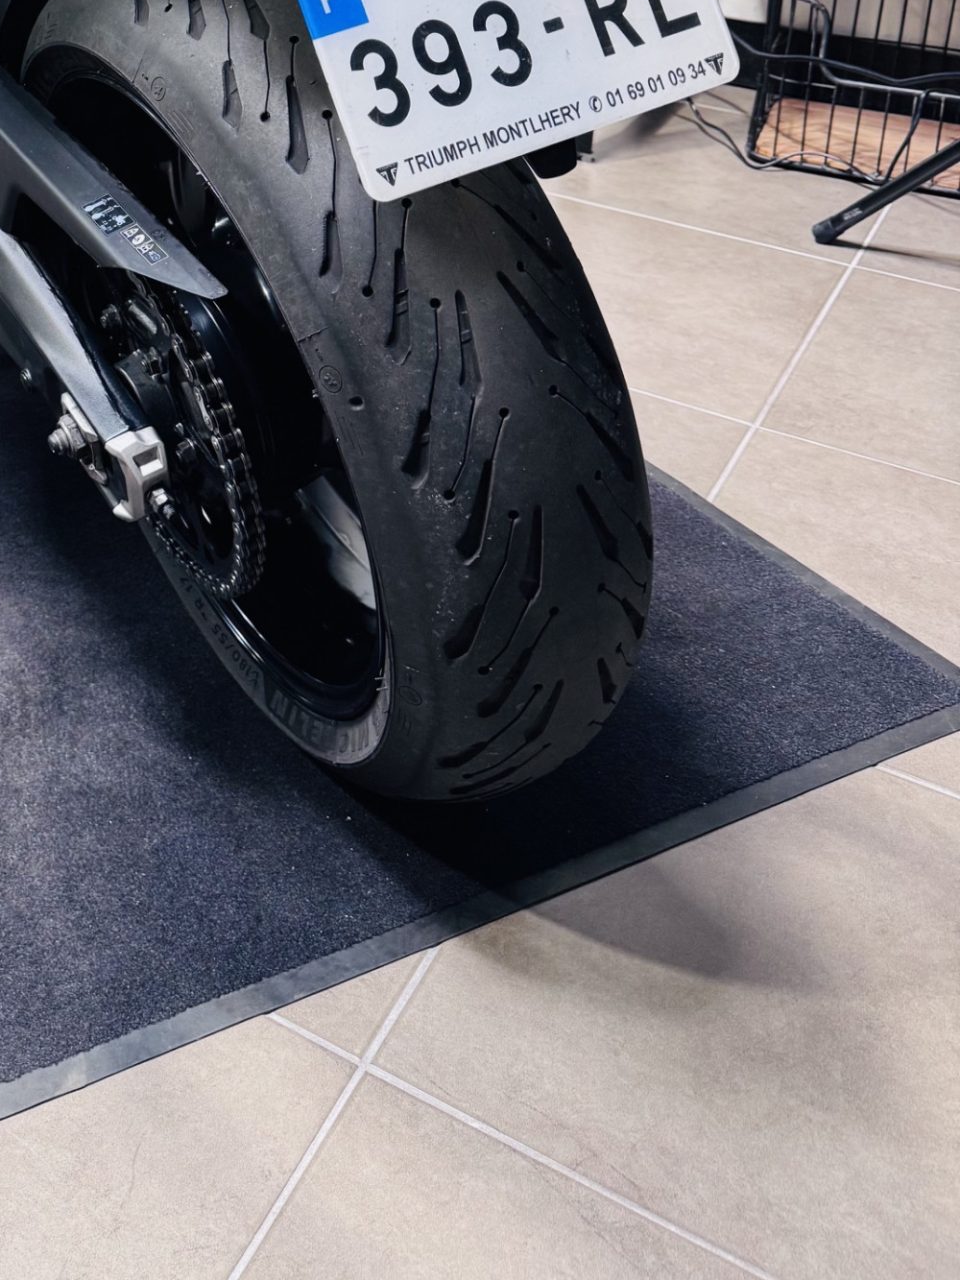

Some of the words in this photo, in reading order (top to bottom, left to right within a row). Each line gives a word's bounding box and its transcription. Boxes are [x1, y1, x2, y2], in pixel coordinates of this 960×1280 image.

[403, 136, 481, 175] TRIUMPH
[483, 101, 583, 150] MONTLHERY
[606, 88, 625, 108] 01
[627, 81, 646, 101] 69
[647, 74, 666, 93] 01
[668, 67, 687, 86] 09
[689, 60, 707, 80] 34
